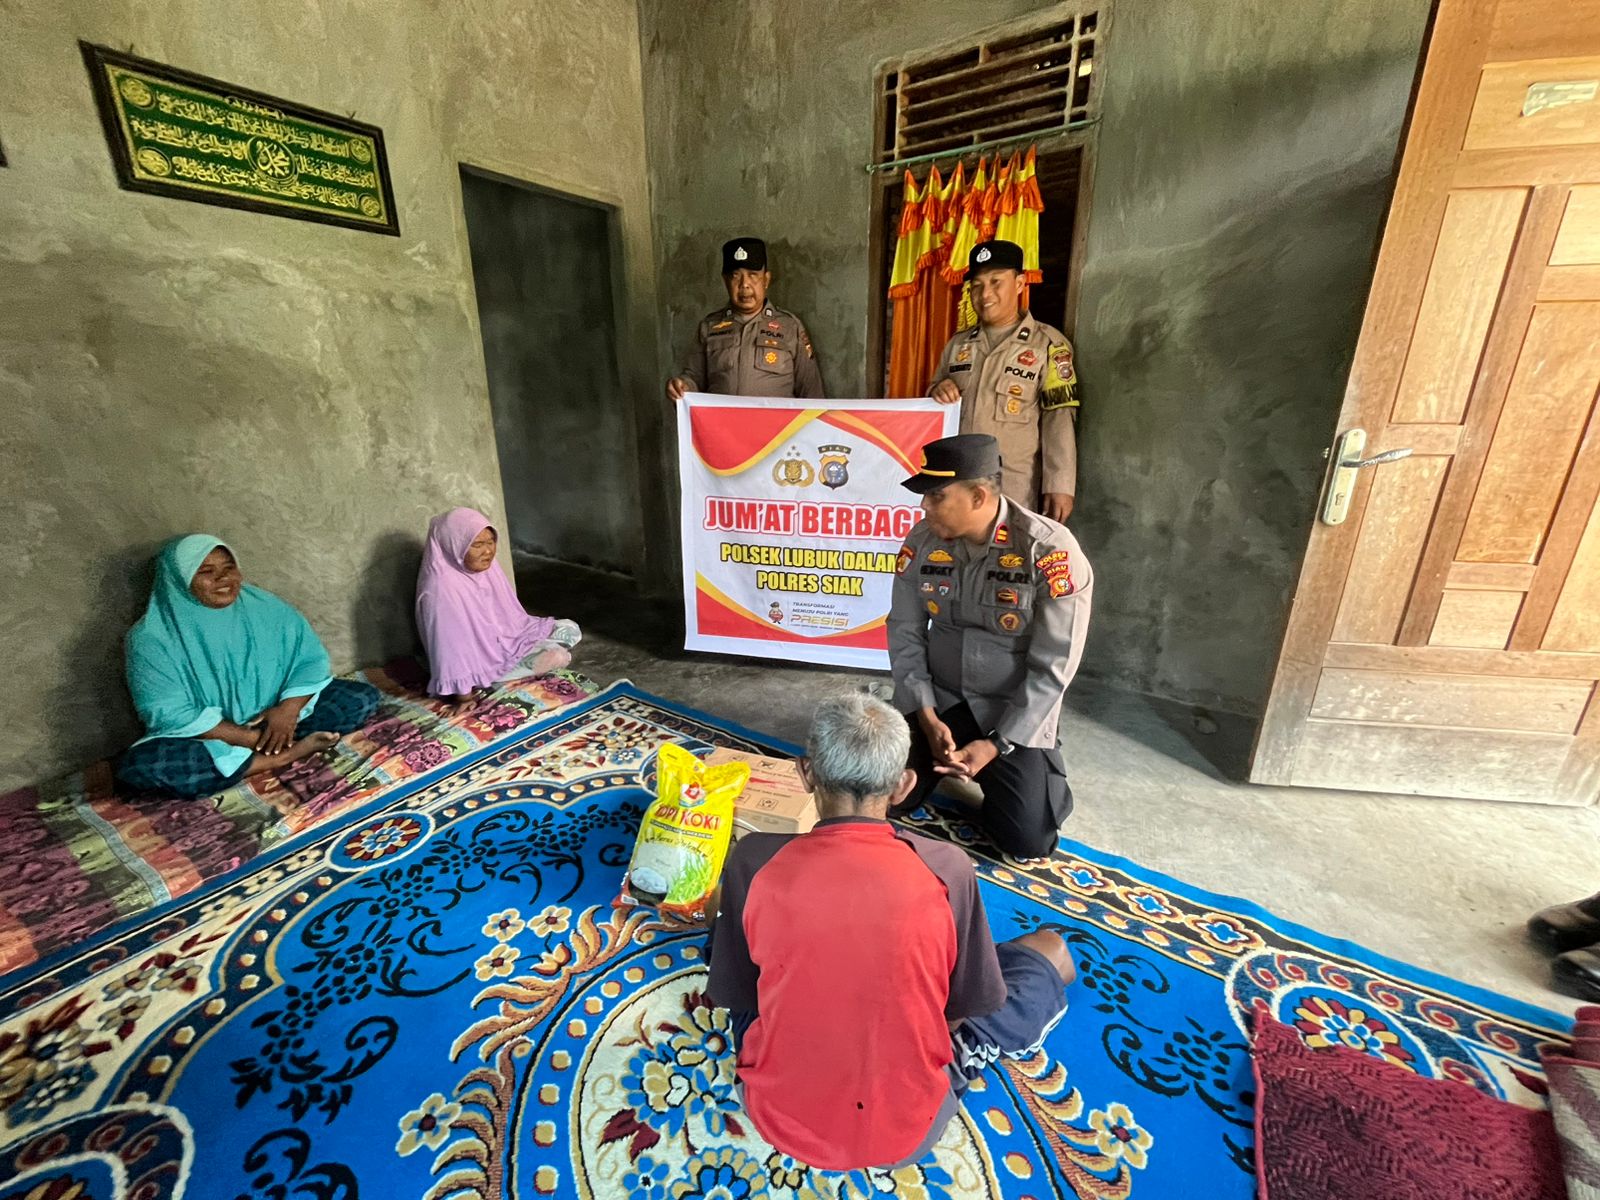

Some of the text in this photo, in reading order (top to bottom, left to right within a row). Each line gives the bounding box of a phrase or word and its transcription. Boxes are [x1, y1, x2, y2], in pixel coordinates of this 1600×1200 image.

[1004, 366, 1037, 381] POLRI
[705, 498, 797, 533] JUM'AT
[720, 542, 781, 567] POLSEK
[783, 548, 841, 570] LUBUK
[756, 570, 864, 596] POLRES SIAK
[987, 570, 1030, 584] POLRI
[679, 809, 721, 831] KOKI
